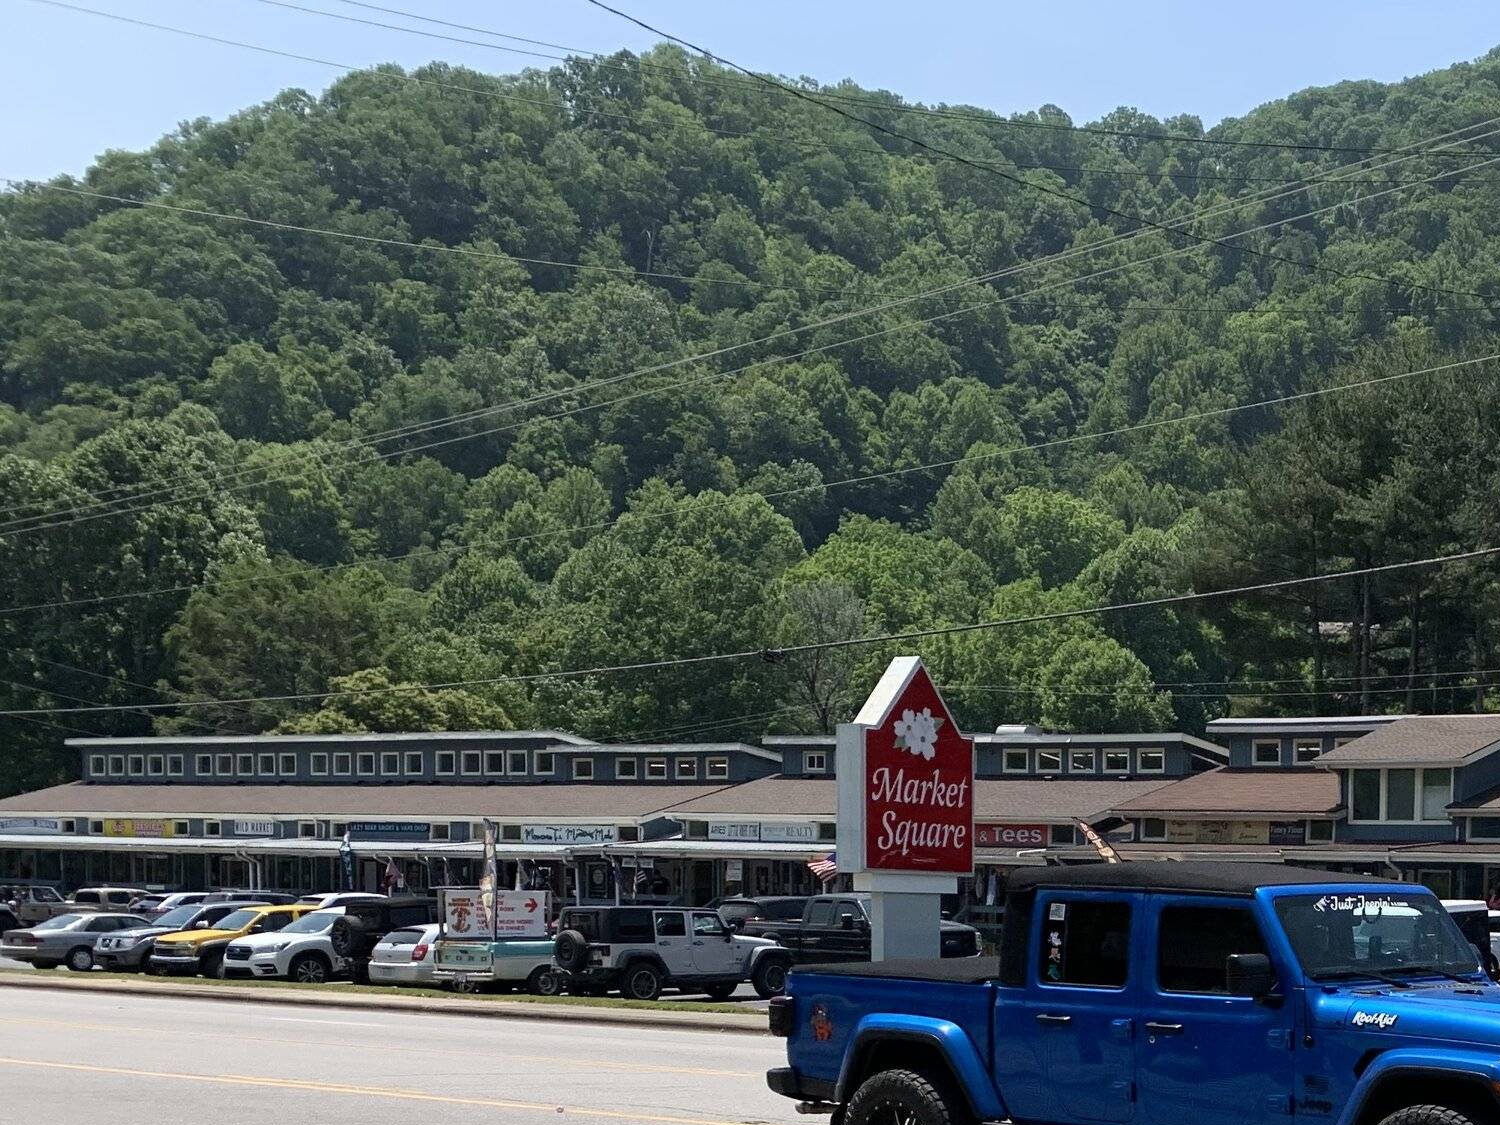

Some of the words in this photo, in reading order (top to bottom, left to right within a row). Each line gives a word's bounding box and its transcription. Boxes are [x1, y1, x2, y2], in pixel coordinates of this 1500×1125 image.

[871, 767, 969, 808] Market
[785, 826, 813, 837] REALTY
[878, 810, 966, 856] Square
[980, 831, 987, 841] &
[992, 826, 1042, 843] Tees
[1330, 896, 1357, 911] Just
[1352, 1011, 1398, 1028] Kool-Aid
